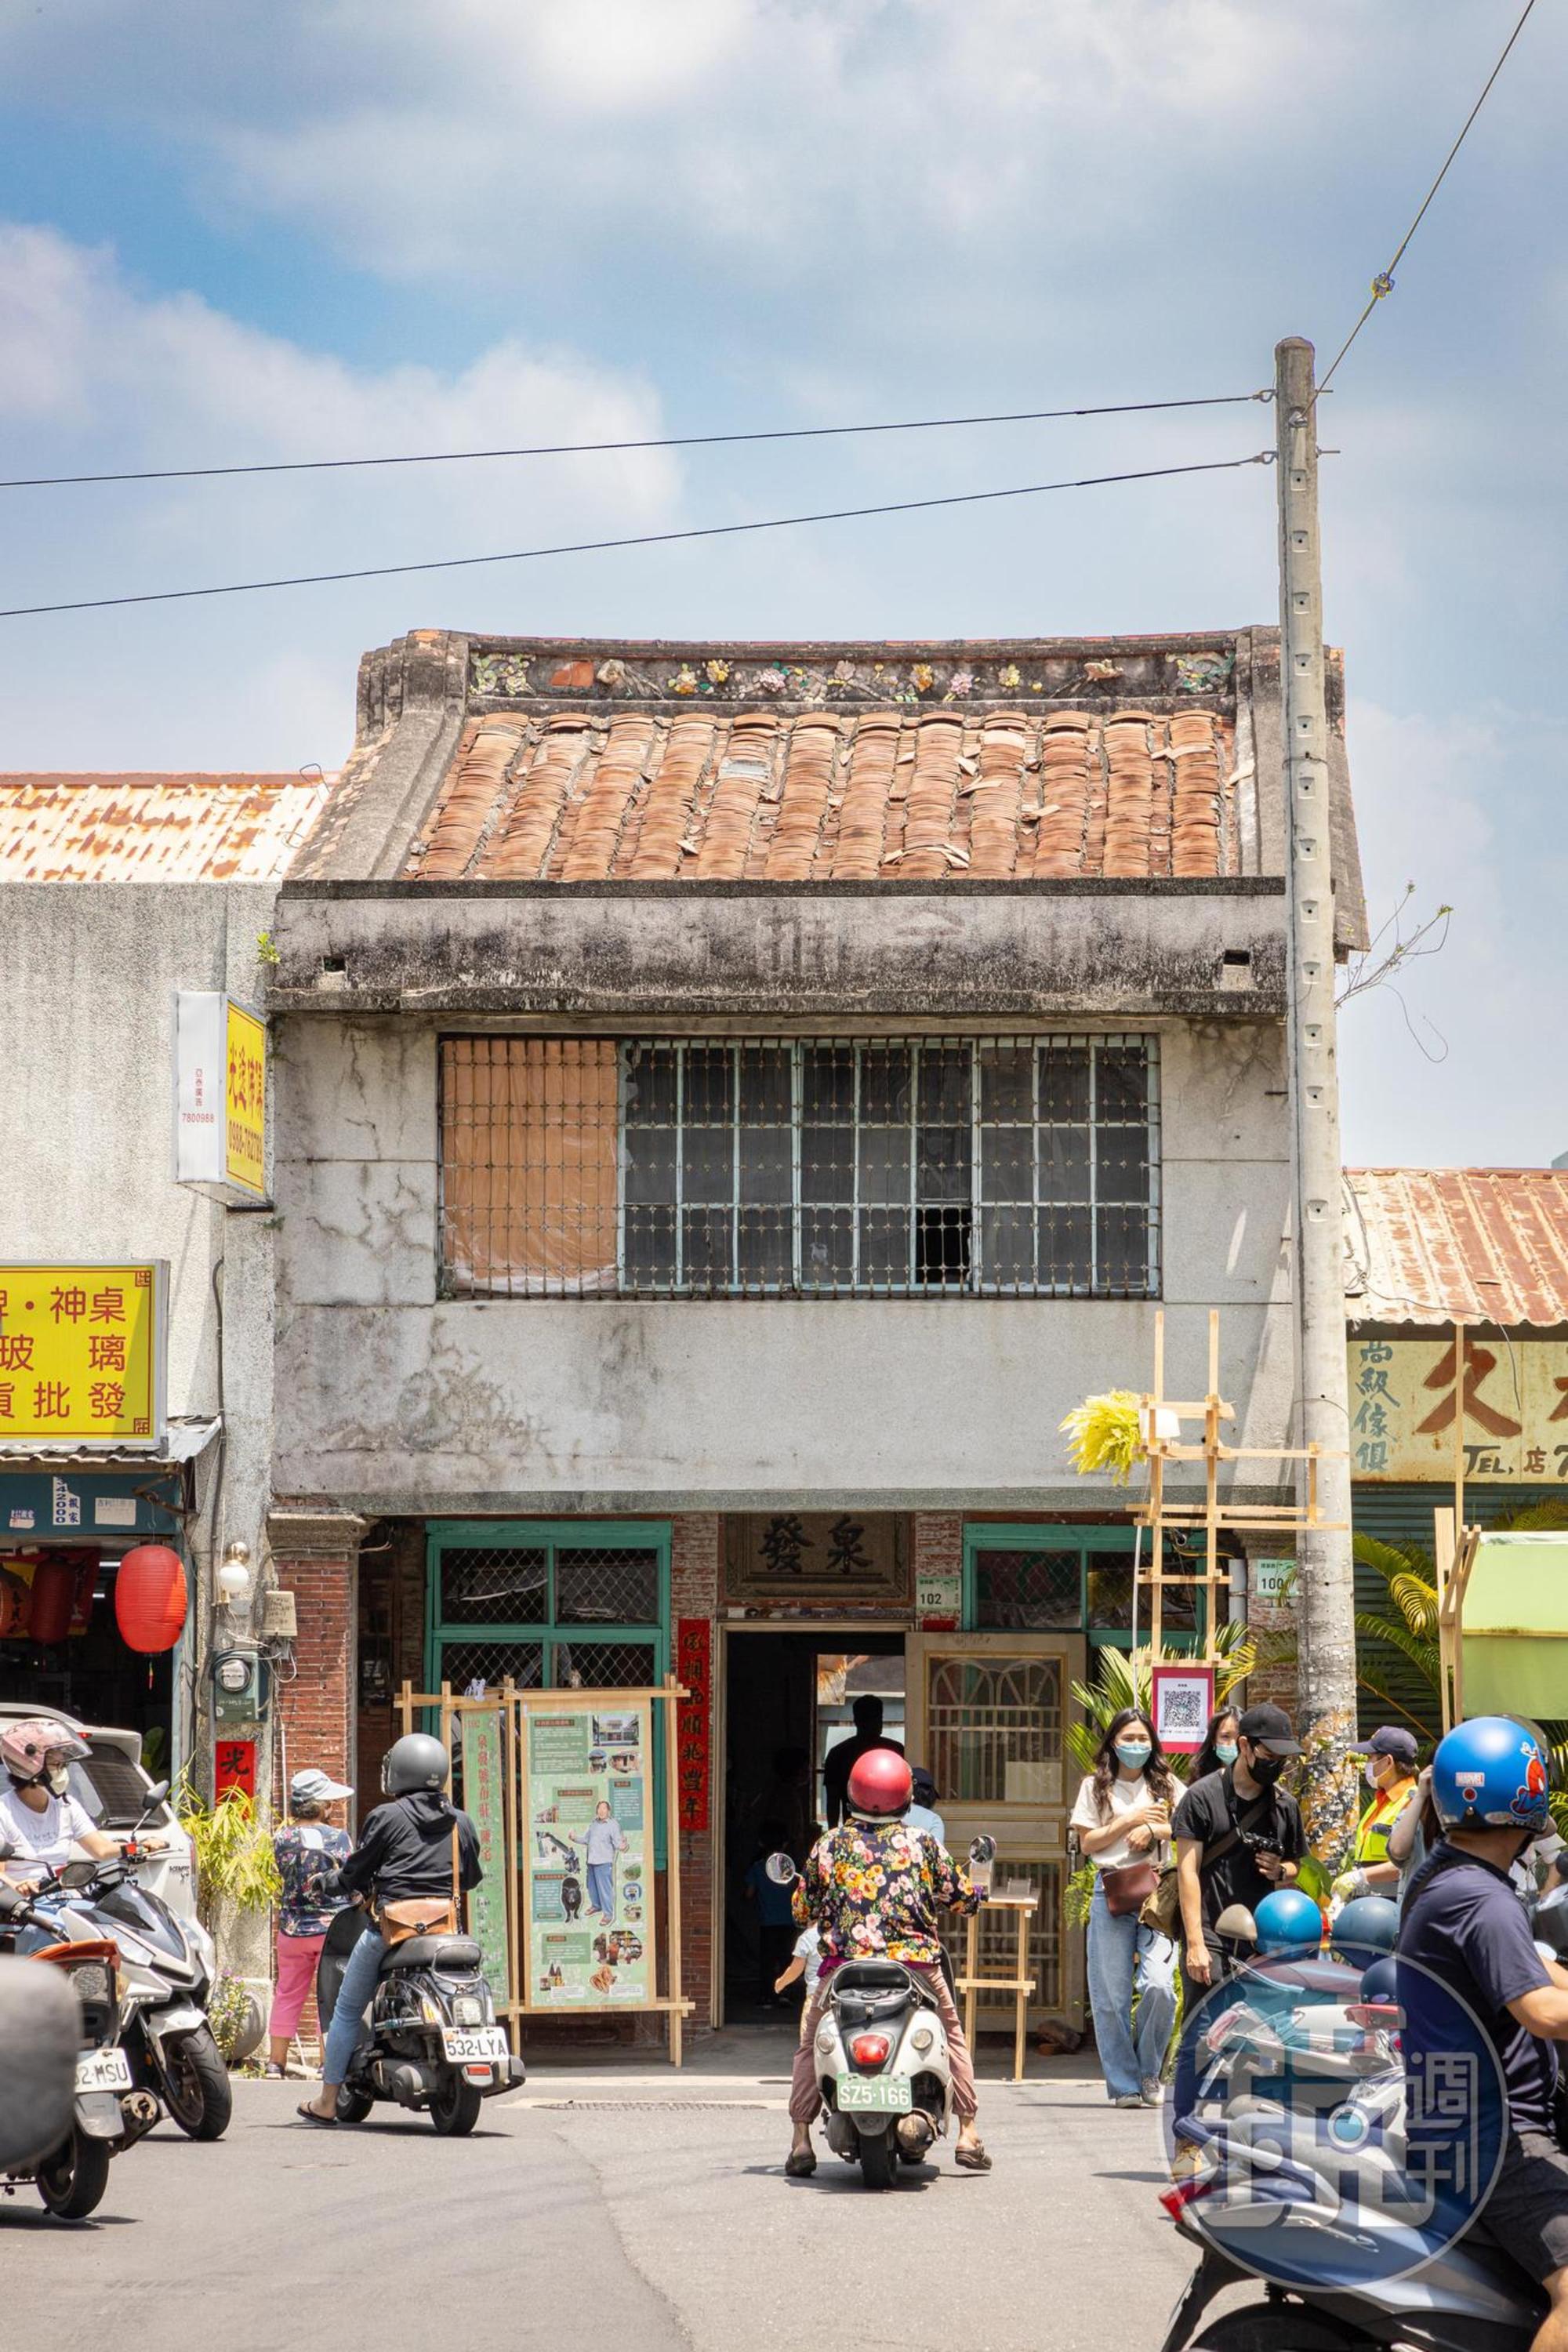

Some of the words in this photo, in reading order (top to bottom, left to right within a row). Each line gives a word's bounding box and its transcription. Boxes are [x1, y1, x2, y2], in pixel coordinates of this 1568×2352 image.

[1353, 1341, 1401, 1473] 高級傢俱
[1261, 1577, 1284, 1590] 100
[920, 1593, 942, 1605] 102
